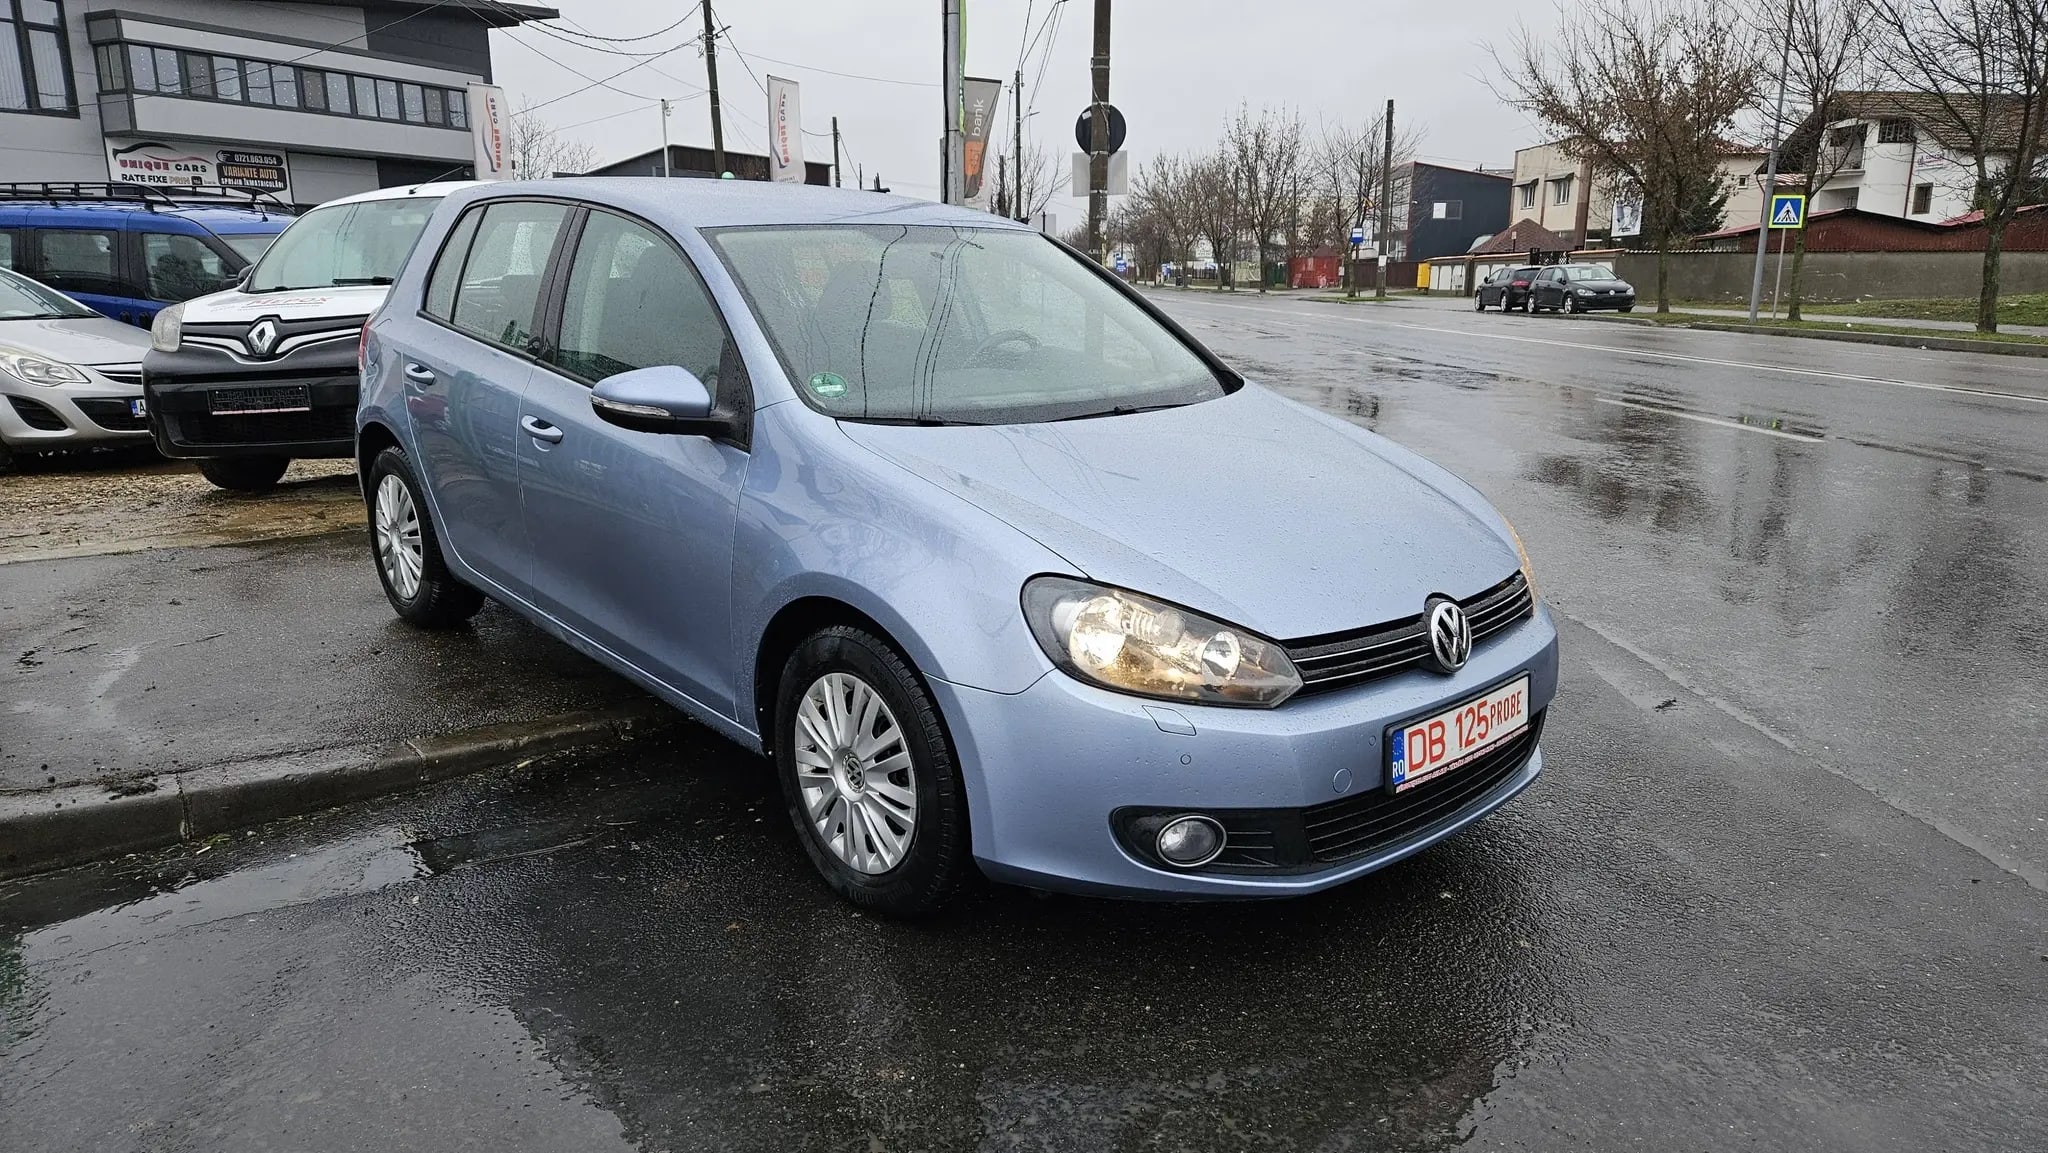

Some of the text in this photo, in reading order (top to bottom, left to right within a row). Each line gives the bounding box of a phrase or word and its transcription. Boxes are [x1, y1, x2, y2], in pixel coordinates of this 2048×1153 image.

[971, 99, 984, 137] bank
[119, 159, 207, 173] UNIQUE CARS
[222, 165, 278, 180] VARIANTE AUTO
[121, 173, 146, 182] RATE
[147, 174, 168, 184] FIXE
[168, 175, 191, 185] PRIN
[1408, 720, 1446, 773] DB
[1455, 700, 1490, 750] 125
[1490, 689, 1522, 730] PROBE
[1392, 759, 1405, 779] RO
